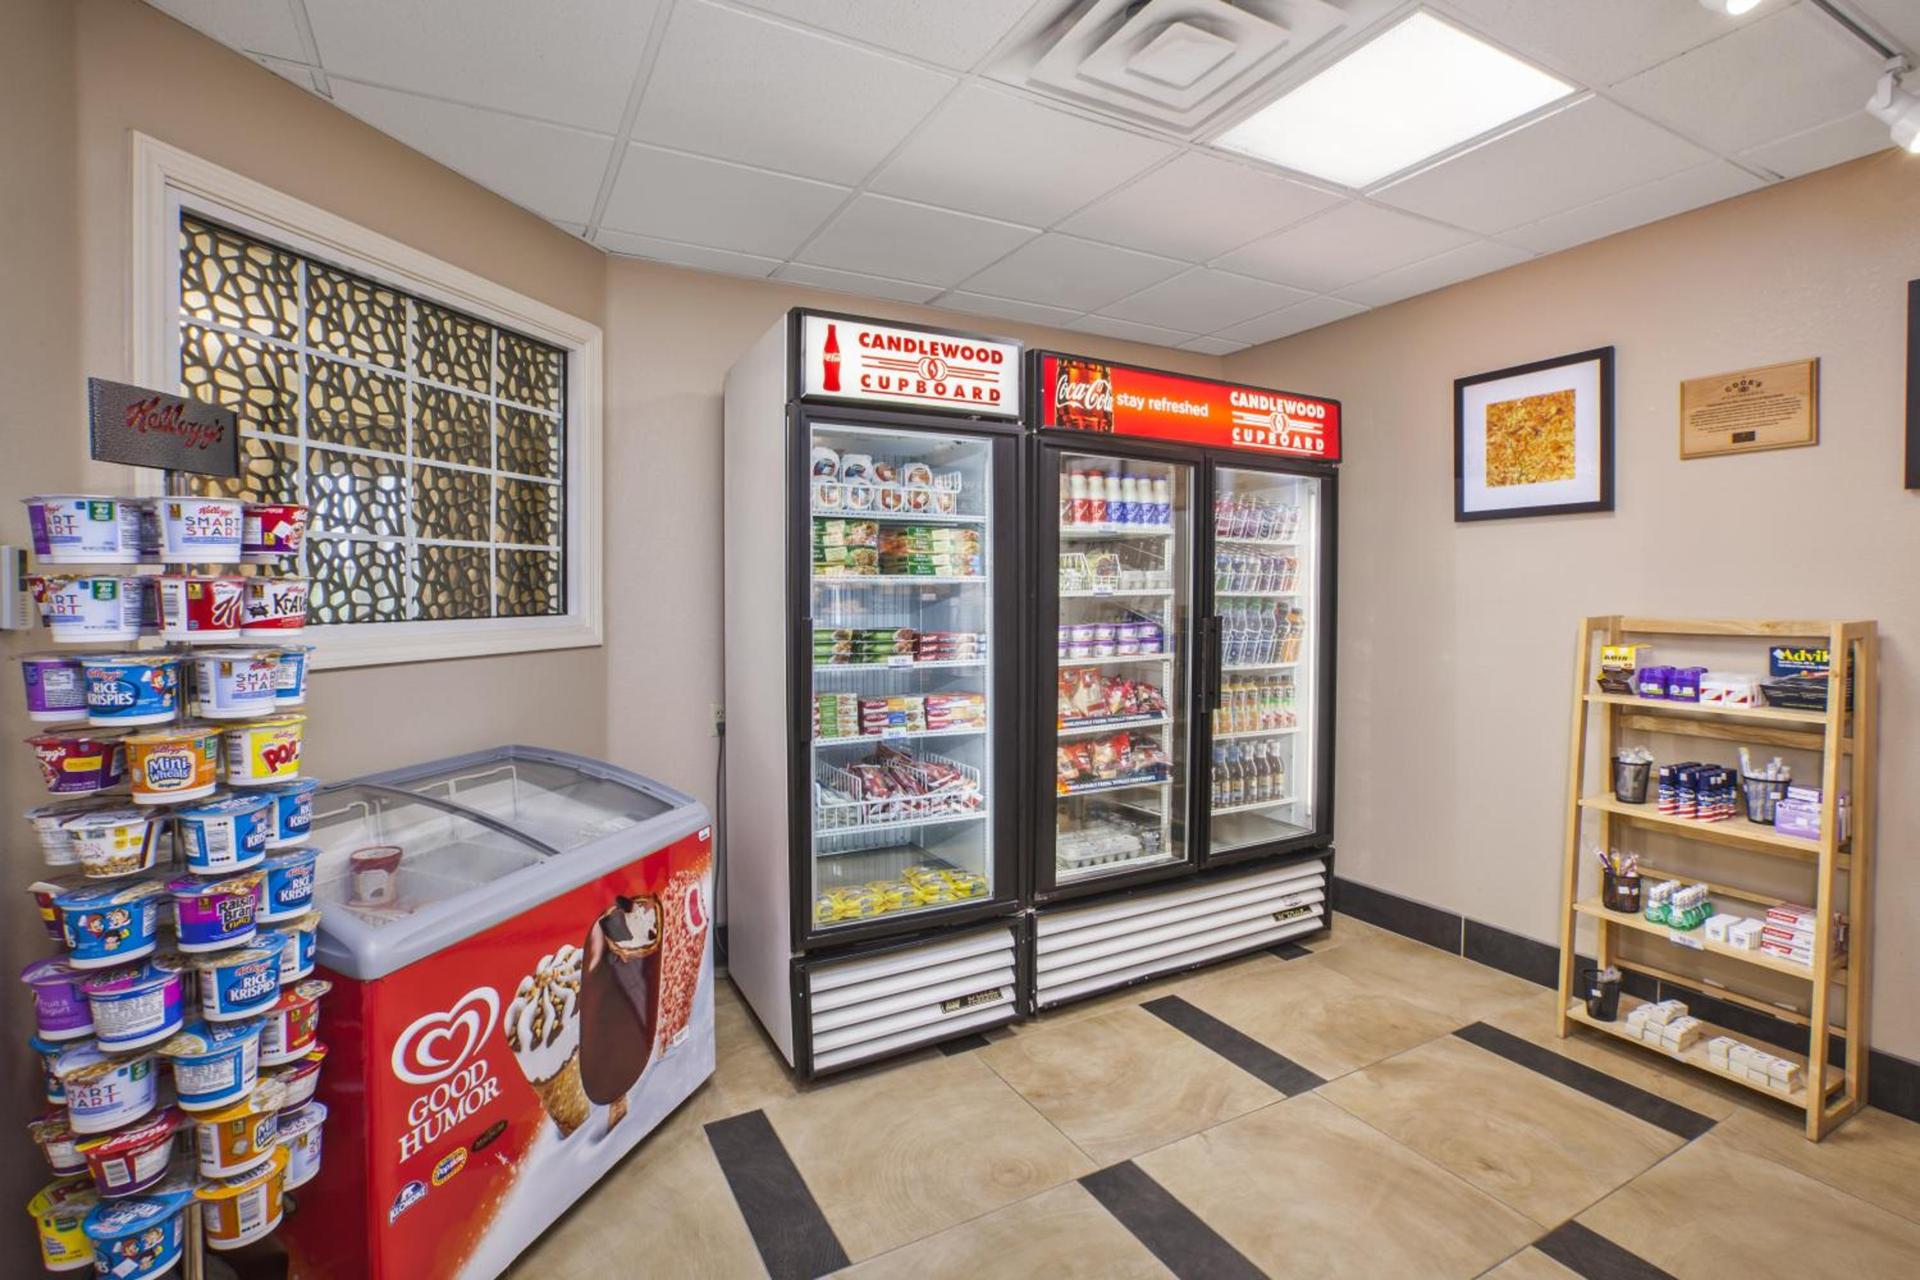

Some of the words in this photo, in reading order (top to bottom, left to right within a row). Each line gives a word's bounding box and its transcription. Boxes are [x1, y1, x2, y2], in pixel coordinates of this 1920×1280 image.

[858, 332, 1003, 365] CANDLEWOOD
[861, 374, 1001, 402] CUPBOARD
[1056, 374, 1113, 413] Coca-Cola
[1116, 393, 1144, 410] stay
[1149, 397, 1209, 417] refreshed
[1230, 391, 1326, 419] CANDLEWOOD
[125, 397, 225, 449] Kellogg's
[1232, 428, 1324, 451] CUPBOARD
[185, 516, 240, 526] SMART
[1781, 648, 1829, 662] Advil
[93, 682, 119, 693] RICE
[218, 895, 255, 915] Raisin
[223, 906, 253, 923] Bran
[230, 981, 275, 1002] KRISPIES
[243, 973, 267, 989] RICE
[408, 1060, 488, 1126] GOOD
[398, 1077, 502, 1164] HUMOR
